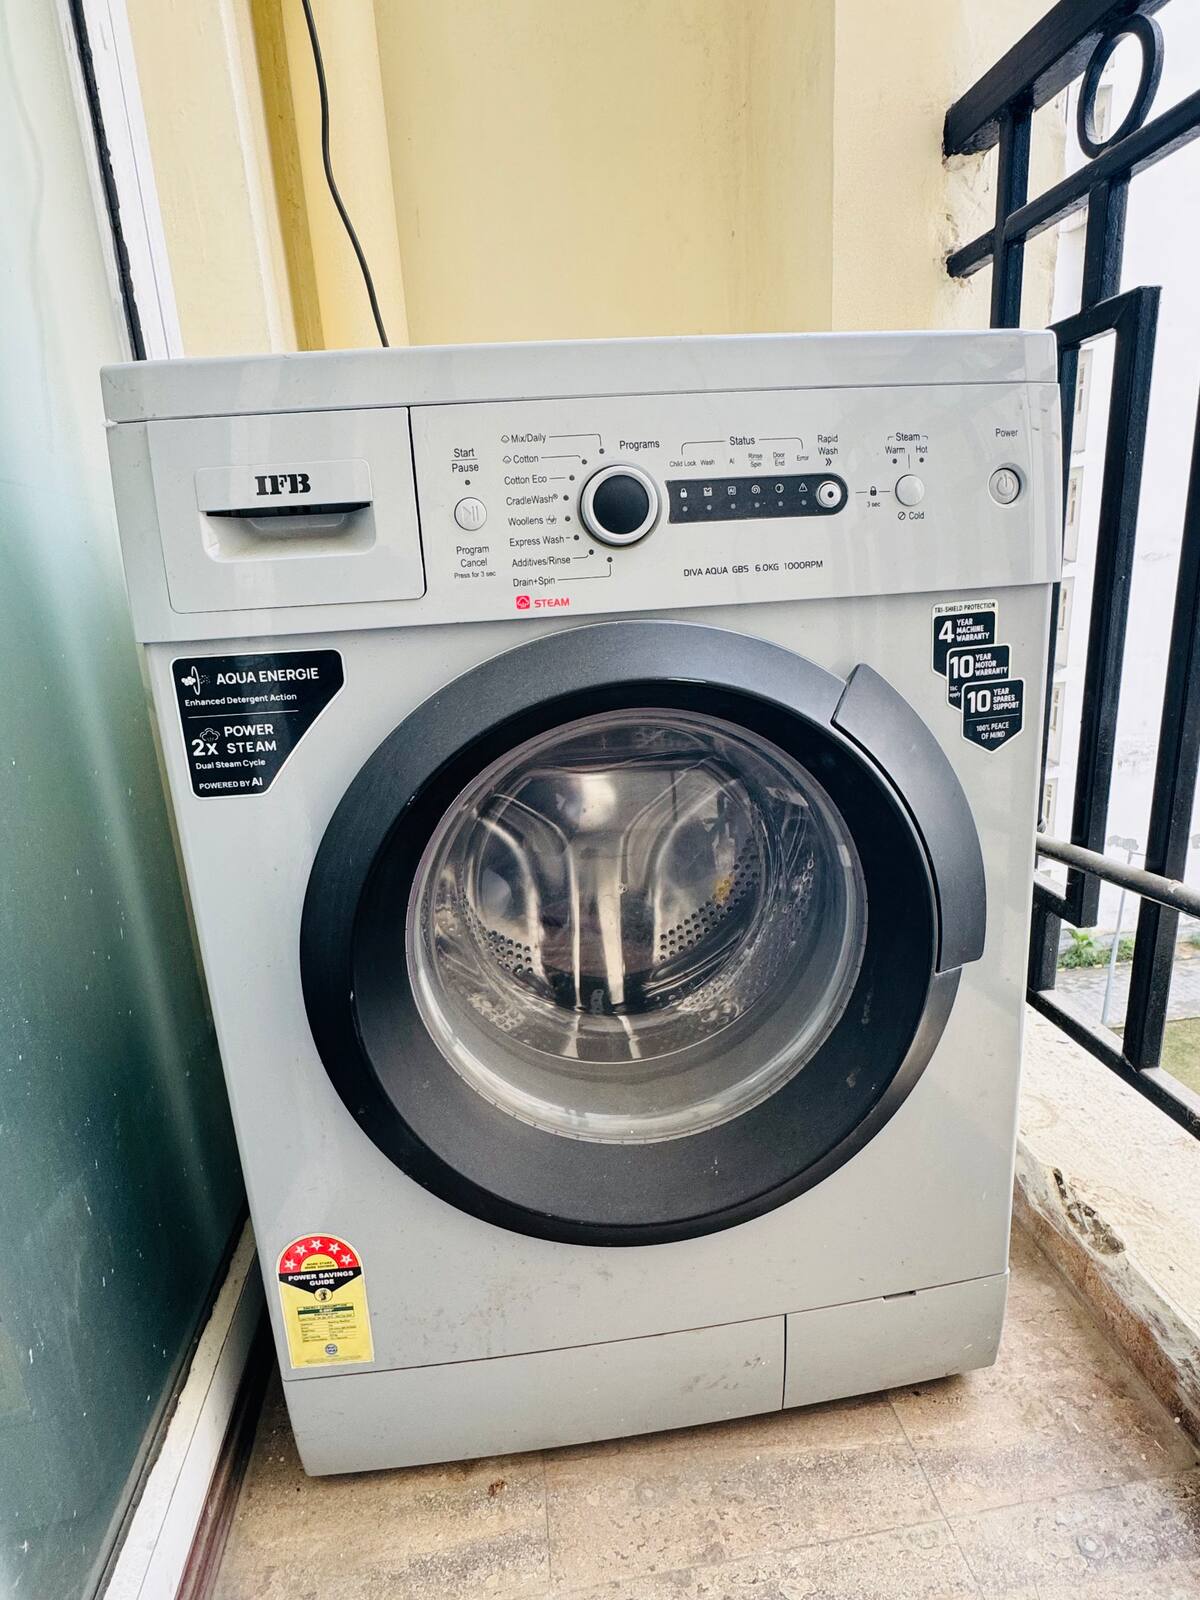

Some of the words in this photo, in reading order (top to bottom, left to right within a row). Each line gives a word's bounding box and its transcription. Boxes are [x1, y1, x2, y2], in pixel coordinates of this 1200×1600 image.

[895, 433, 920, 442] Steam
[995, 428, 1018, 437] Power
[510, 433, 547, 444] Mix/Daily
[729, 436, 756, 446] Status
[817, 435, 839, 444] Rapid
[619, 440, 660, 452] Programs
[817, 447, 839, 455] Wash
[885, 446, 906, 454] Warm
[916, 445, 928, 454] Hot
[454, 448, 475, 458] Start
[513, 454, 539, 464] Cotton
[669, 460, 683, 468] Child
[451, 463, 479, 473] Pause
[254, 474, 311, 496] IFB
[504, 475, 530, 486] Cotton
[532, 474, 548, 484] Eco
[508, 516, 544, 526] Woollens
[908, 512, 924, 520] Cold
[509, 536, 541, 547] Express
[542, 535, 565, 545] Wash
[456, 545, 490, 556] Program
[460, 558, 488, 568] Cancel
[512, 556, 571, 568] Additives/Rinse
[684, 568, 703, 576] DIVA
[705, 566, 728, 575] AQUA
[755, 563, 779, 572] 6.0KG
[784, 560, 823, 570] 1000RPM
[454, 571, 473, 579] Press
[512, 576, 556, 588] Drain+Spin
[534, 598, 570, 608] STEAM
[964, 602, 996, 610] PROTECTION
[956, 618, 973, 626] YEAR
[938, 620, 954, 643] 4
[956, 624, 984, 634] MACHINE
[956, 632, 990, 642] WARRANTY
[976, 653, 992, 661] YEAR
[950, 655, 974, 678] 10
[975, 660, 996, 668] MOTOR
[975, 666, 1008, 676] WARRANTY
[216, 671, 256, 686] AQUA
[258, 668, 320, 683] ENERGIE
[993, 688, 1010, 696] YEAR
[184, 698, 226, 707] Enhanced
[226, 695, 268, 705] Detergent
[270, 693, 297, 702] Action
[967, 690, 991, 714] 10
[992, 694, 1016, 703] SPARES
[992, 702, 1020, 710] SUPPORT
[224, 724, 274, 737] POWER
[976, 724, 990, 732] 100%
[990, 722, 1009, 730] PEACE
[981, 732, 989, 740] OF
[990, 731, 1006, 739] MIND
[192, 739, 219, 756] 2x
[226, 740, 277, 754] STEAM
[196, 762, 214, 770] Dual
[216, 760, 242, 768] Steam
[243, 758, 266, 768] Cycle
[199, 781, 238, 790] POWERED
[240, 780, 250, 788] BY
[252, 777, 263, 786] AI
[288, 1274, 317, 1282] POWER
[318, 1270, 354, 1278] SAVINGS
[310, 1278, 335, 1286] GUIDE
